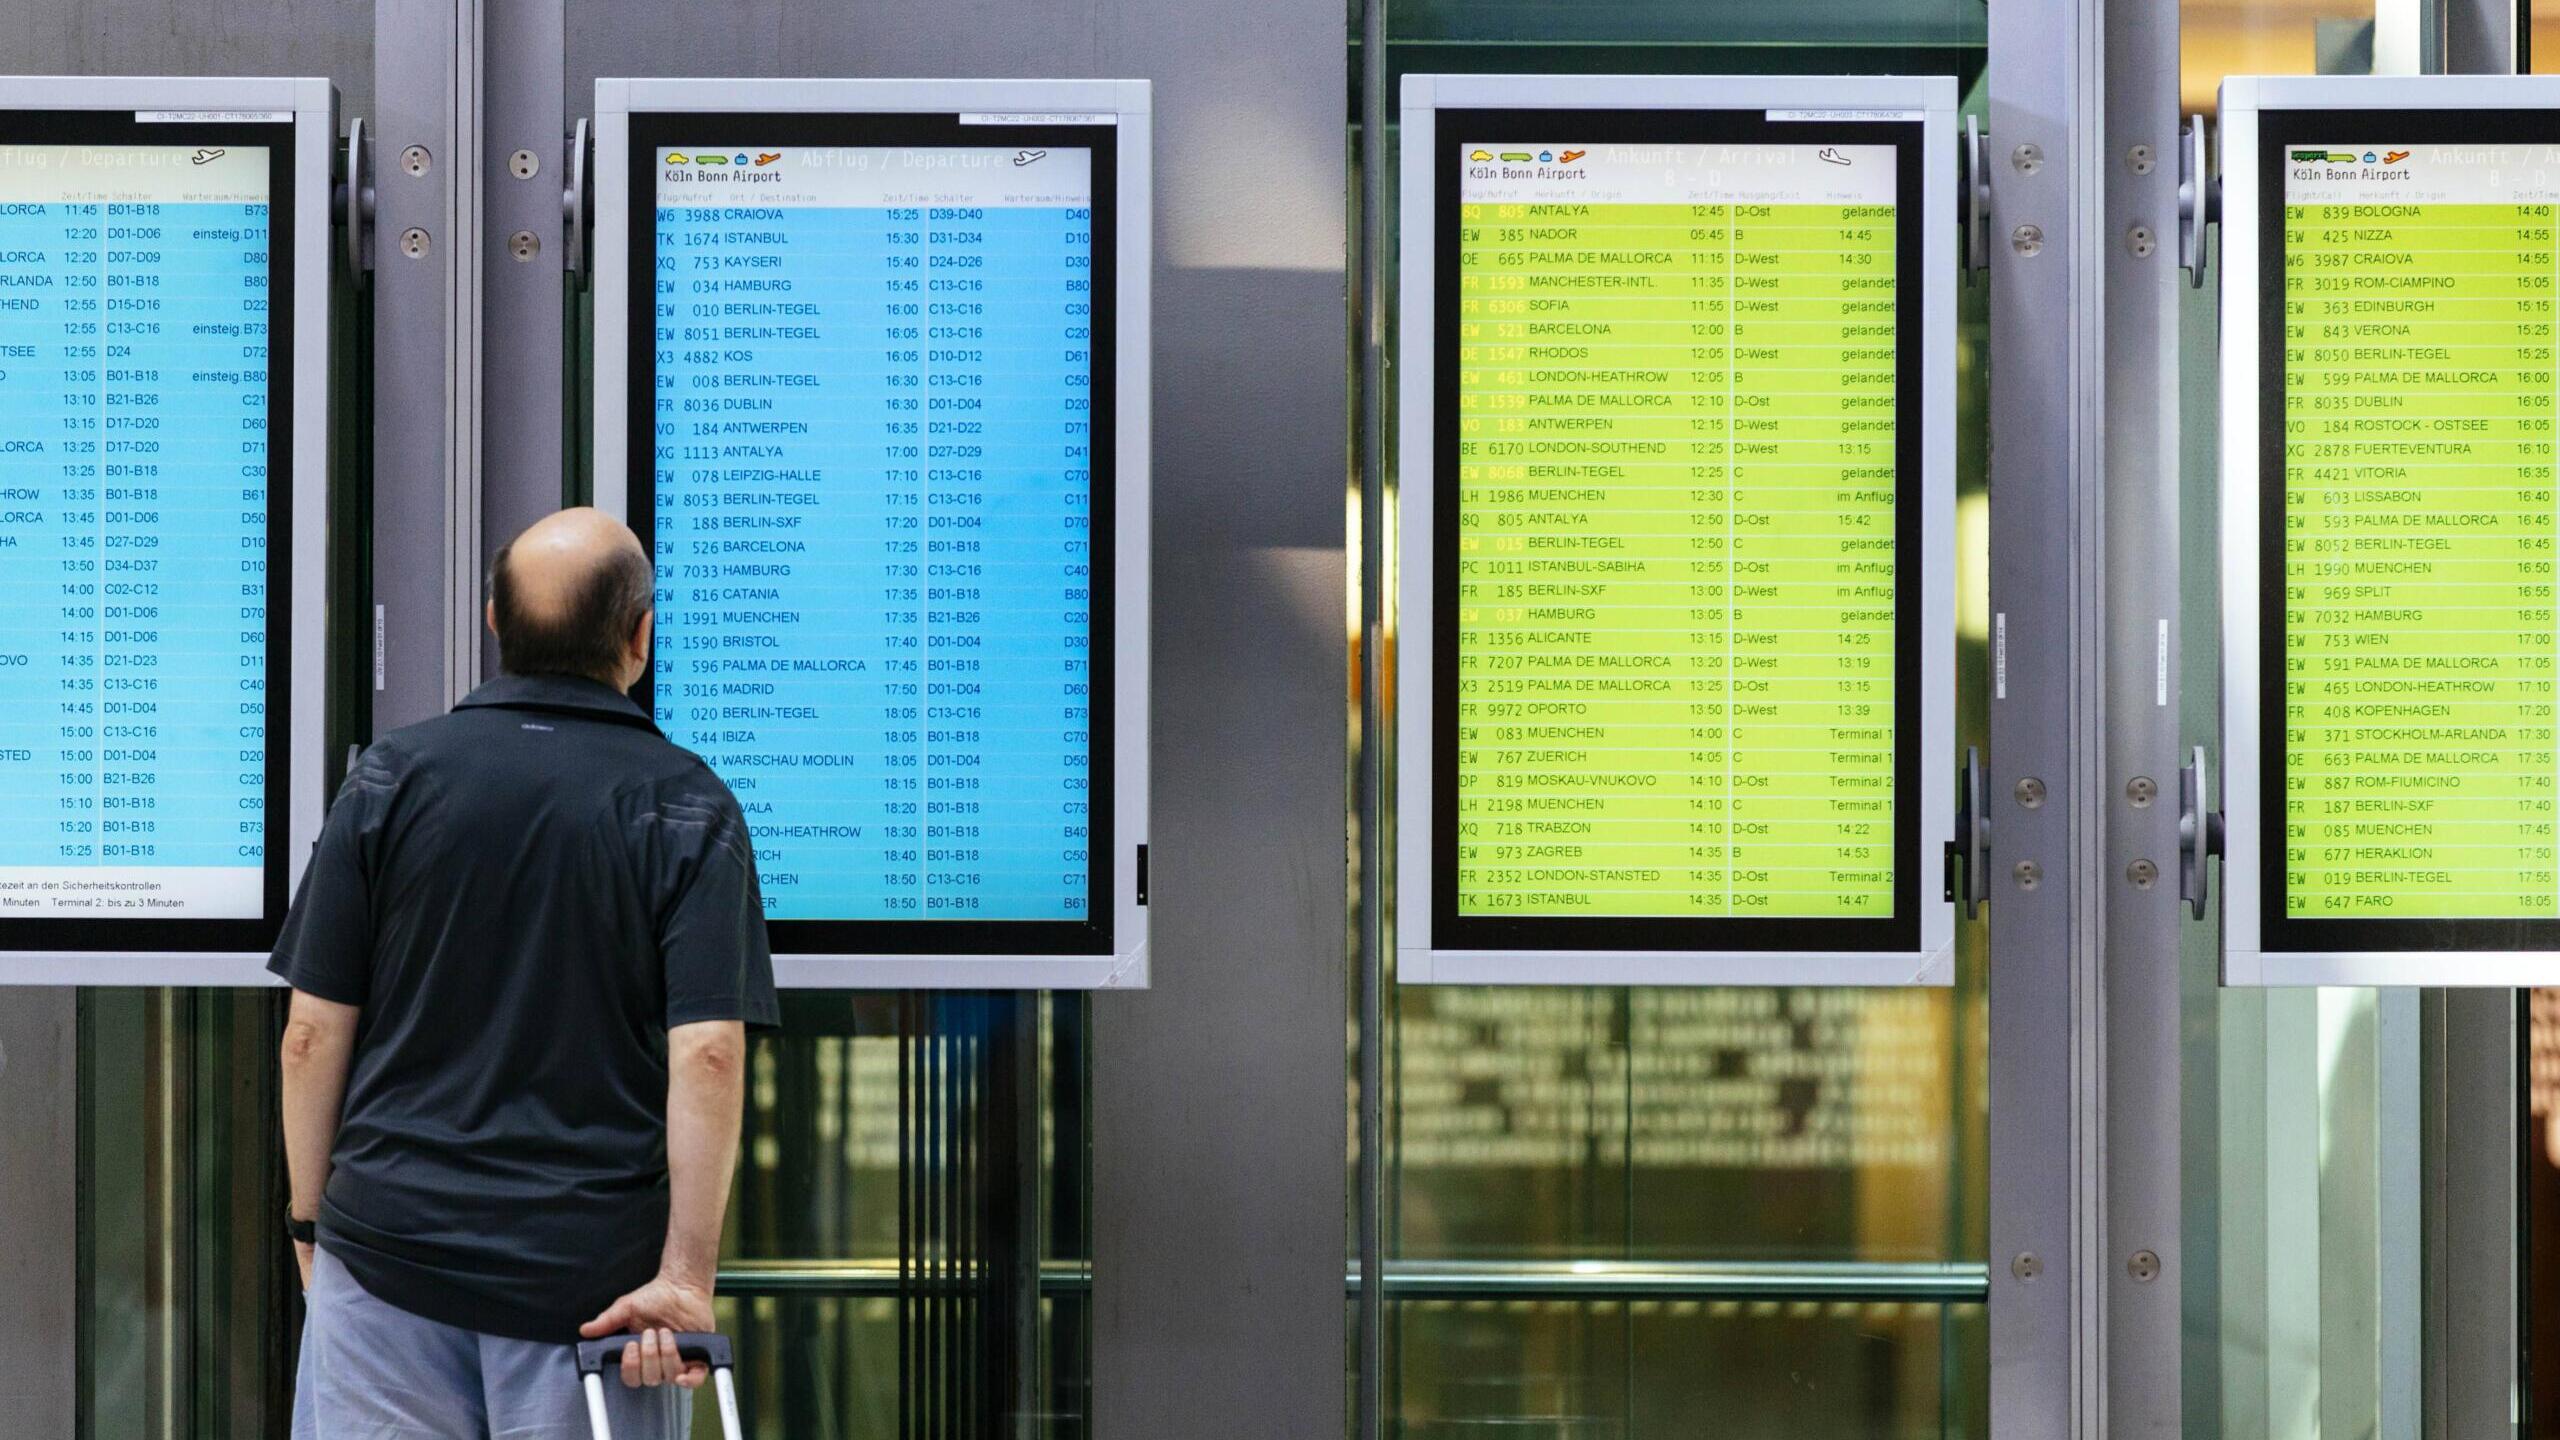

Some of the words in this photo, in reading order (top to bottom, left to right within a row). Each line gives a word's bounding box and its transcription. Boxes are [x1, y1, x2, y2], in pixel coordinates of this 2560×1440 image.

[802, 151, 868, 169] Abflug
[904, 151, 1004, 169] Departure
[665, 170, 692, 182] Köln
[699, 170, 728, 182] Bonn
[733, 170, 782, 183] Airport
[1469, 168, 1497, 179] Köln
[1502, 168, 1532, 179] Bonn
[1537, 168, 1586, 180] Airport
[2293, 168, 2321, 180] Köln
[2326, 168, 2357, 180] Bonn
[2362, 169, 2410, 181] Airport
[657, 209, 674, 222] W6
[686, 209, 720, 222] 3988
[725, 208, 784, 220] CRAIOVA
[887, 209, 918, 220] 15:25
[930, 208, 982, 220] D39-D40
[1066, 208, 1090, 220] D40
[2287, 207, 2304, 219] EW
[2323, 207, 2349, 219] 839
[2354, 206, 2421, 217] BOLOGNA
[1462, 229, 1479, 241] EW
[1500, 229, 1524, 241] 385
[1530, 228, 1577, 239] NADOR
[657, 280, 674, 293] EW
[693, 280, 718, 293] 034
[725, 280, 791, 291] HAMBURG
[887, 280, 918, 291] 15:45
[929, 280, 982, 291] C13-C16
[1066, 280, 1090, 291] B80
[2287, 301, 2304, 314] EW
[2324, 301, 2349, 314] 363
[2355, 301, 2434, 312] EDINBURGH
[656, 351, 673, 364] X3
[684, 351, 718, 364] 4882
[724, 350, 752, 361] KOS
[886, 351, 918, 362] 16:05
[929, 350, 982, 361] D10-D12
[1066, 350, 1089, 361] D61
[64, 394, 95, 405] 13:10
[107, 394, 158, 405] B21-B26
[243, 394, 266, 405] C21
[657, 399, 673, 412] FR
[684, 399, 719, 412] 8036
[724, 399, 772, 410] DUBLIN
[886, 399, 918, 410] 16:30
[929, 398, 982, 409] D01-D04
[1066, 398, 1089, 409] D20
[2287, 397, 2303, 409] FR
[2355, 396, 2402, 407] DUBLIN
[64, 418, 95, 429] 13:15
[107, 418, 159, 428] D17-D20
[243, 418, 266, 428] D60
[1461, 442, 1477, 455] BE
[1529, 442, 1666, 453] LONDON-SOUTHEND
[1735, 443, 1778, 454] D-West
[63, 465, 95, 476] 13:25
[106, 465, 157, 476] B01-B18
[242, 465, 266, 476] C30
[656, 541, 674, 554] EW
[693, 541, 718, 554] 526
[723, 541, 805, 552] BARCELONA
[885, 541, 918, 552] 17:25
[929, 541, 980, 552] B01-B18
[1065, 541, 1088, 552] C71
[62, 560, 94, 571] 13:50
[106, 560, 158, 571] D34-D37
[242, 560, 265, 571] D10
[62, 584, 94, 595] 14:00
[105, 584, 158, 594] C02-C12
[243, 584, 264, 594] B31
[2287, 610, 2305, 624] EW
[2355, 610, 2422, 620] HAMBURG
[655, 636, 672, 649] FR
[683, 636, 718, 649] 1590
[723, 636, 779, 647] BRISTOL
[885, 637, 917, 647] 17:40
[928, 636, 980, 647] D01-D04
[1065, 636, 1088, 647] D30
[1461, 632, 1477, 645] FR
[1488, 632, 1523, 645] 1356
[1528, 632, 1592, 643] ALICANTE
[1734, 633, 1777, 644] D-West
[61, 679, 93, 690] 14:35
[104, 679, 157, 689] C13-C16
[241, 679, 264, 689] C40
[1460, 728, 1478, 740] EW
[1528, 727, 1604, 738] MUENCHEN
[1829, 729, 1882, 739] Terminal
[2287, 730, 2305, 742] EW
[2325, 730, 2350, 742] 371
[2356, 729, 2507, 740] STOCKHOLM-ARLANDA
[60, 773, 92, 784] 15:00
[104, 773, 155, 784] B21-B26
[240, 773, 263, 784] C20
[1497, 823, 1522, 835] 718
[1527, 822, 1590, 833] TRABZON
[1733, 823, 1768, 834] D-Ost
[2287, 825, 2305, 837] EW
[2356, 824, 2432, 835] MUENCHEN
[60, 845, 92, 856] 15:25
[103, 845, 154, 856] B01-B18
[239, 845, 263, 856] C40
[42, 882, 59, 890] den
[62, 882, 161, 890] Sicherheitskontrollen
[3, 898, 40, 907] Minuten
[52, 898, 92, 907] Terminal
[108, 899, 122, 908] bis
[124, 900, 136, 908] zu
[138, 899, 145, 908] 3
[147, 899, 184, 908] Minuten
[2287, 896, 2305, 908] EW
[2325, 896, 2350, 908] 647
[2356, 896, 2393, 906] FARO
